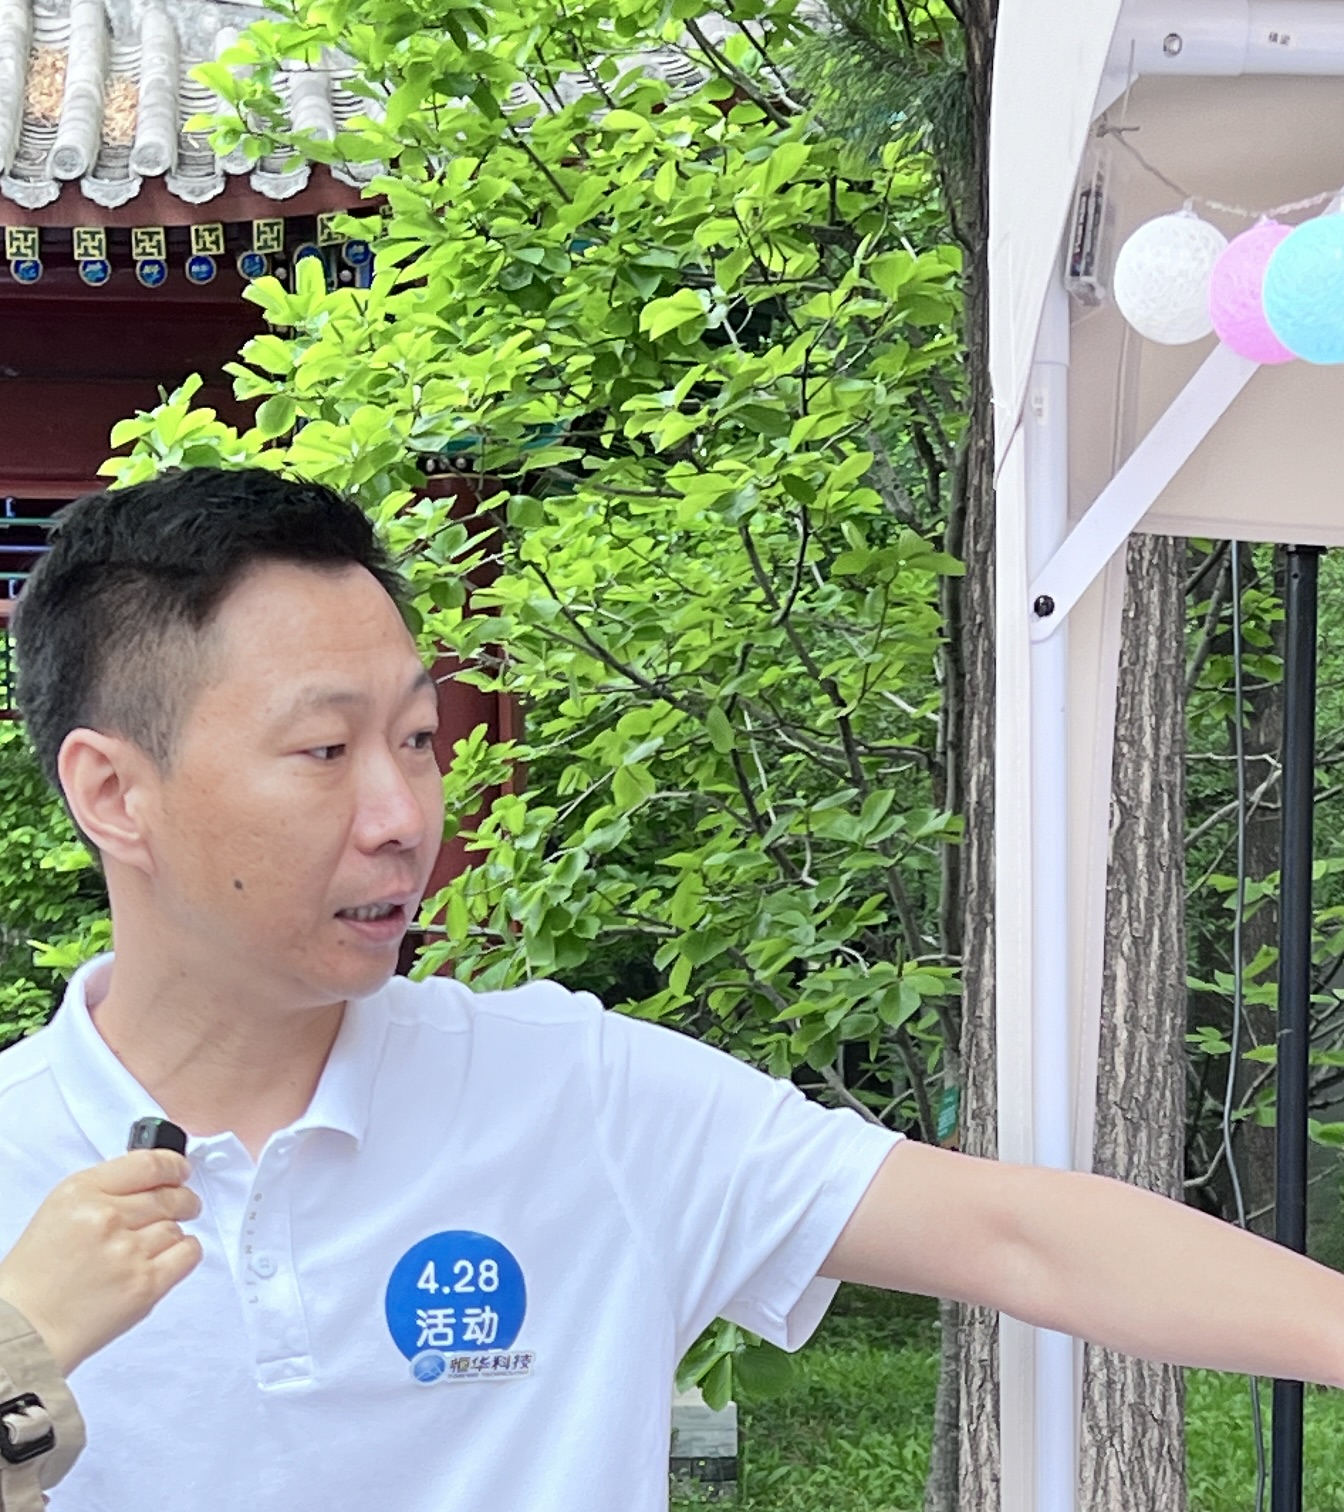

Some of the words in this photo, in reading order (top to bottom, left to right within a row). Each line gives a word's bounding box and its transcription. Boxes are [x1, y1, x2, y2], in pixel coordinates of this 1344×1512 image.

[416, 1258, 500, 1294] 4.28
[415, 1305, 499, 1347] 活动
[450, 1353, 533, 1373] 恒华科技
